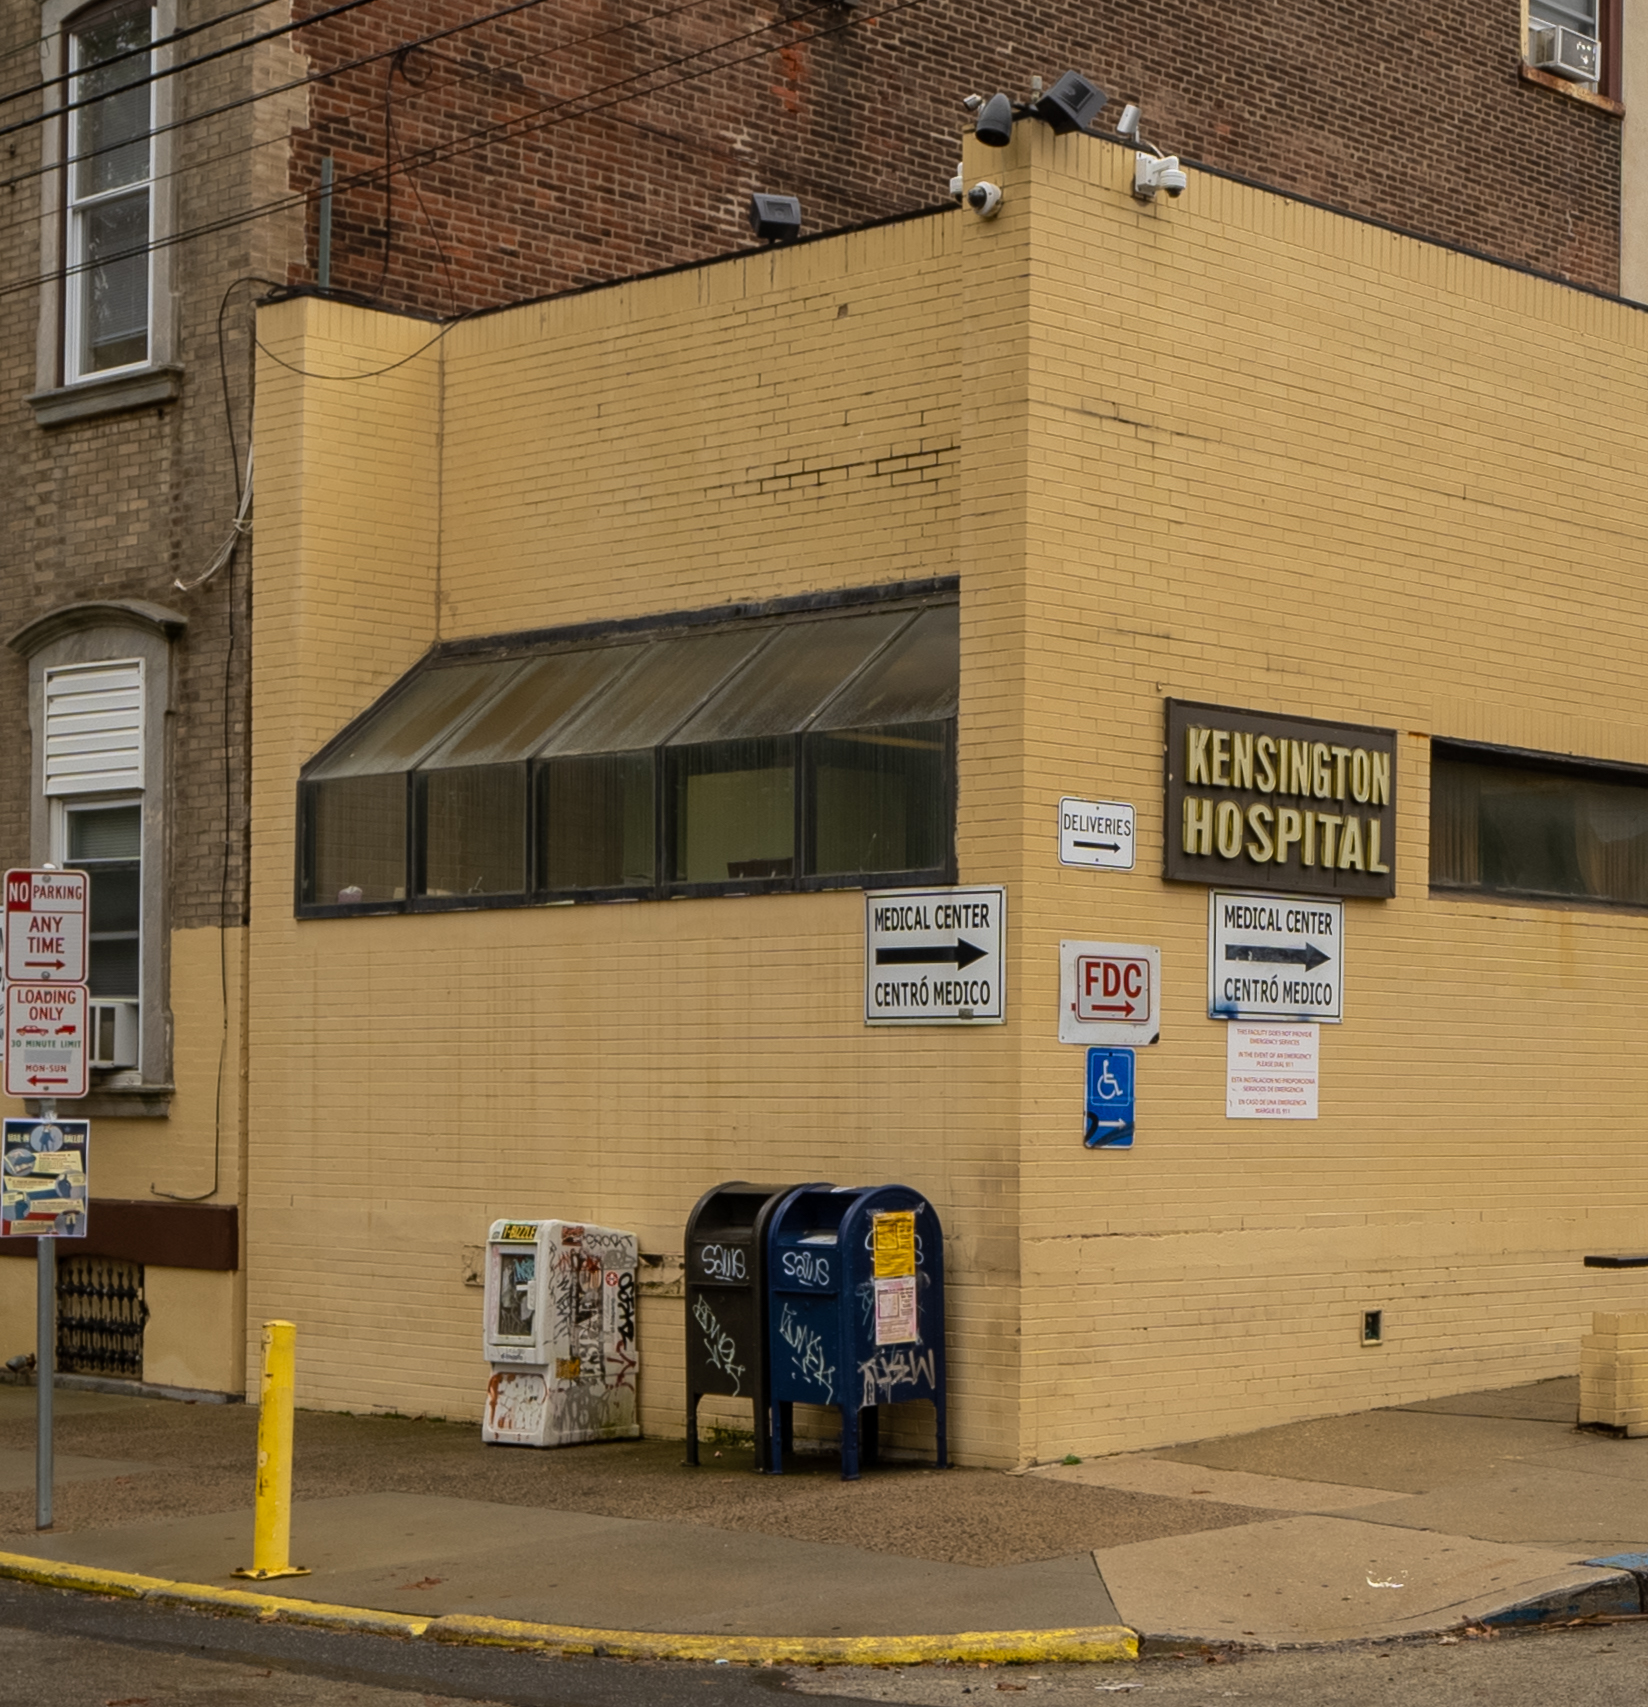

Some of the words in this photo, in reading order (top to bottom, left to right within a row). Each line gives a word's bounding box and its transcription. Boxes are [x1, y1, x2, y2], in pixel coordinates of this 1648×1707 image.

[1185, 723, 1391, 806] KENSINGTON
[1063, 813, 1132, 837] DELIVERIES
[1183, 795, 1390, 874] HOSPITAL
[8, 882, 30, 903] NO
[33, 885, 83, 900] PARKING
[29, 916, 63, 933] ANY
[874, 905, 931, 932] MEDICAL
[934, 903, 991, 930] CENTER
[1224, 904, 1283, 933] MEDICAL
[1285, 909, 1333, 936] CENTER
[26, 937, 66, 954] TIME
[1084, 960, 1143, 999] FDC
[1224, 974, 1280, 1004] CENTRÓ
[1283, 980, 1333, 1006] MEDICO
[17, 990, 77, 1004] LOADING
[874, 974, 930, 1008] CENTRÓ
[933, 979, 991, 1006] MEDICO
[29, 1006, 64, 1021] ONLY
[11, 1040, 22, 1048] 30
[26, 1040, 56, 1048] MINUTE
[61, 1040, 82, 1049] LIMIT
[25, 1064, 67, 1072] MON-SUN
[63, 1134, 85, 1143] BALLOT
